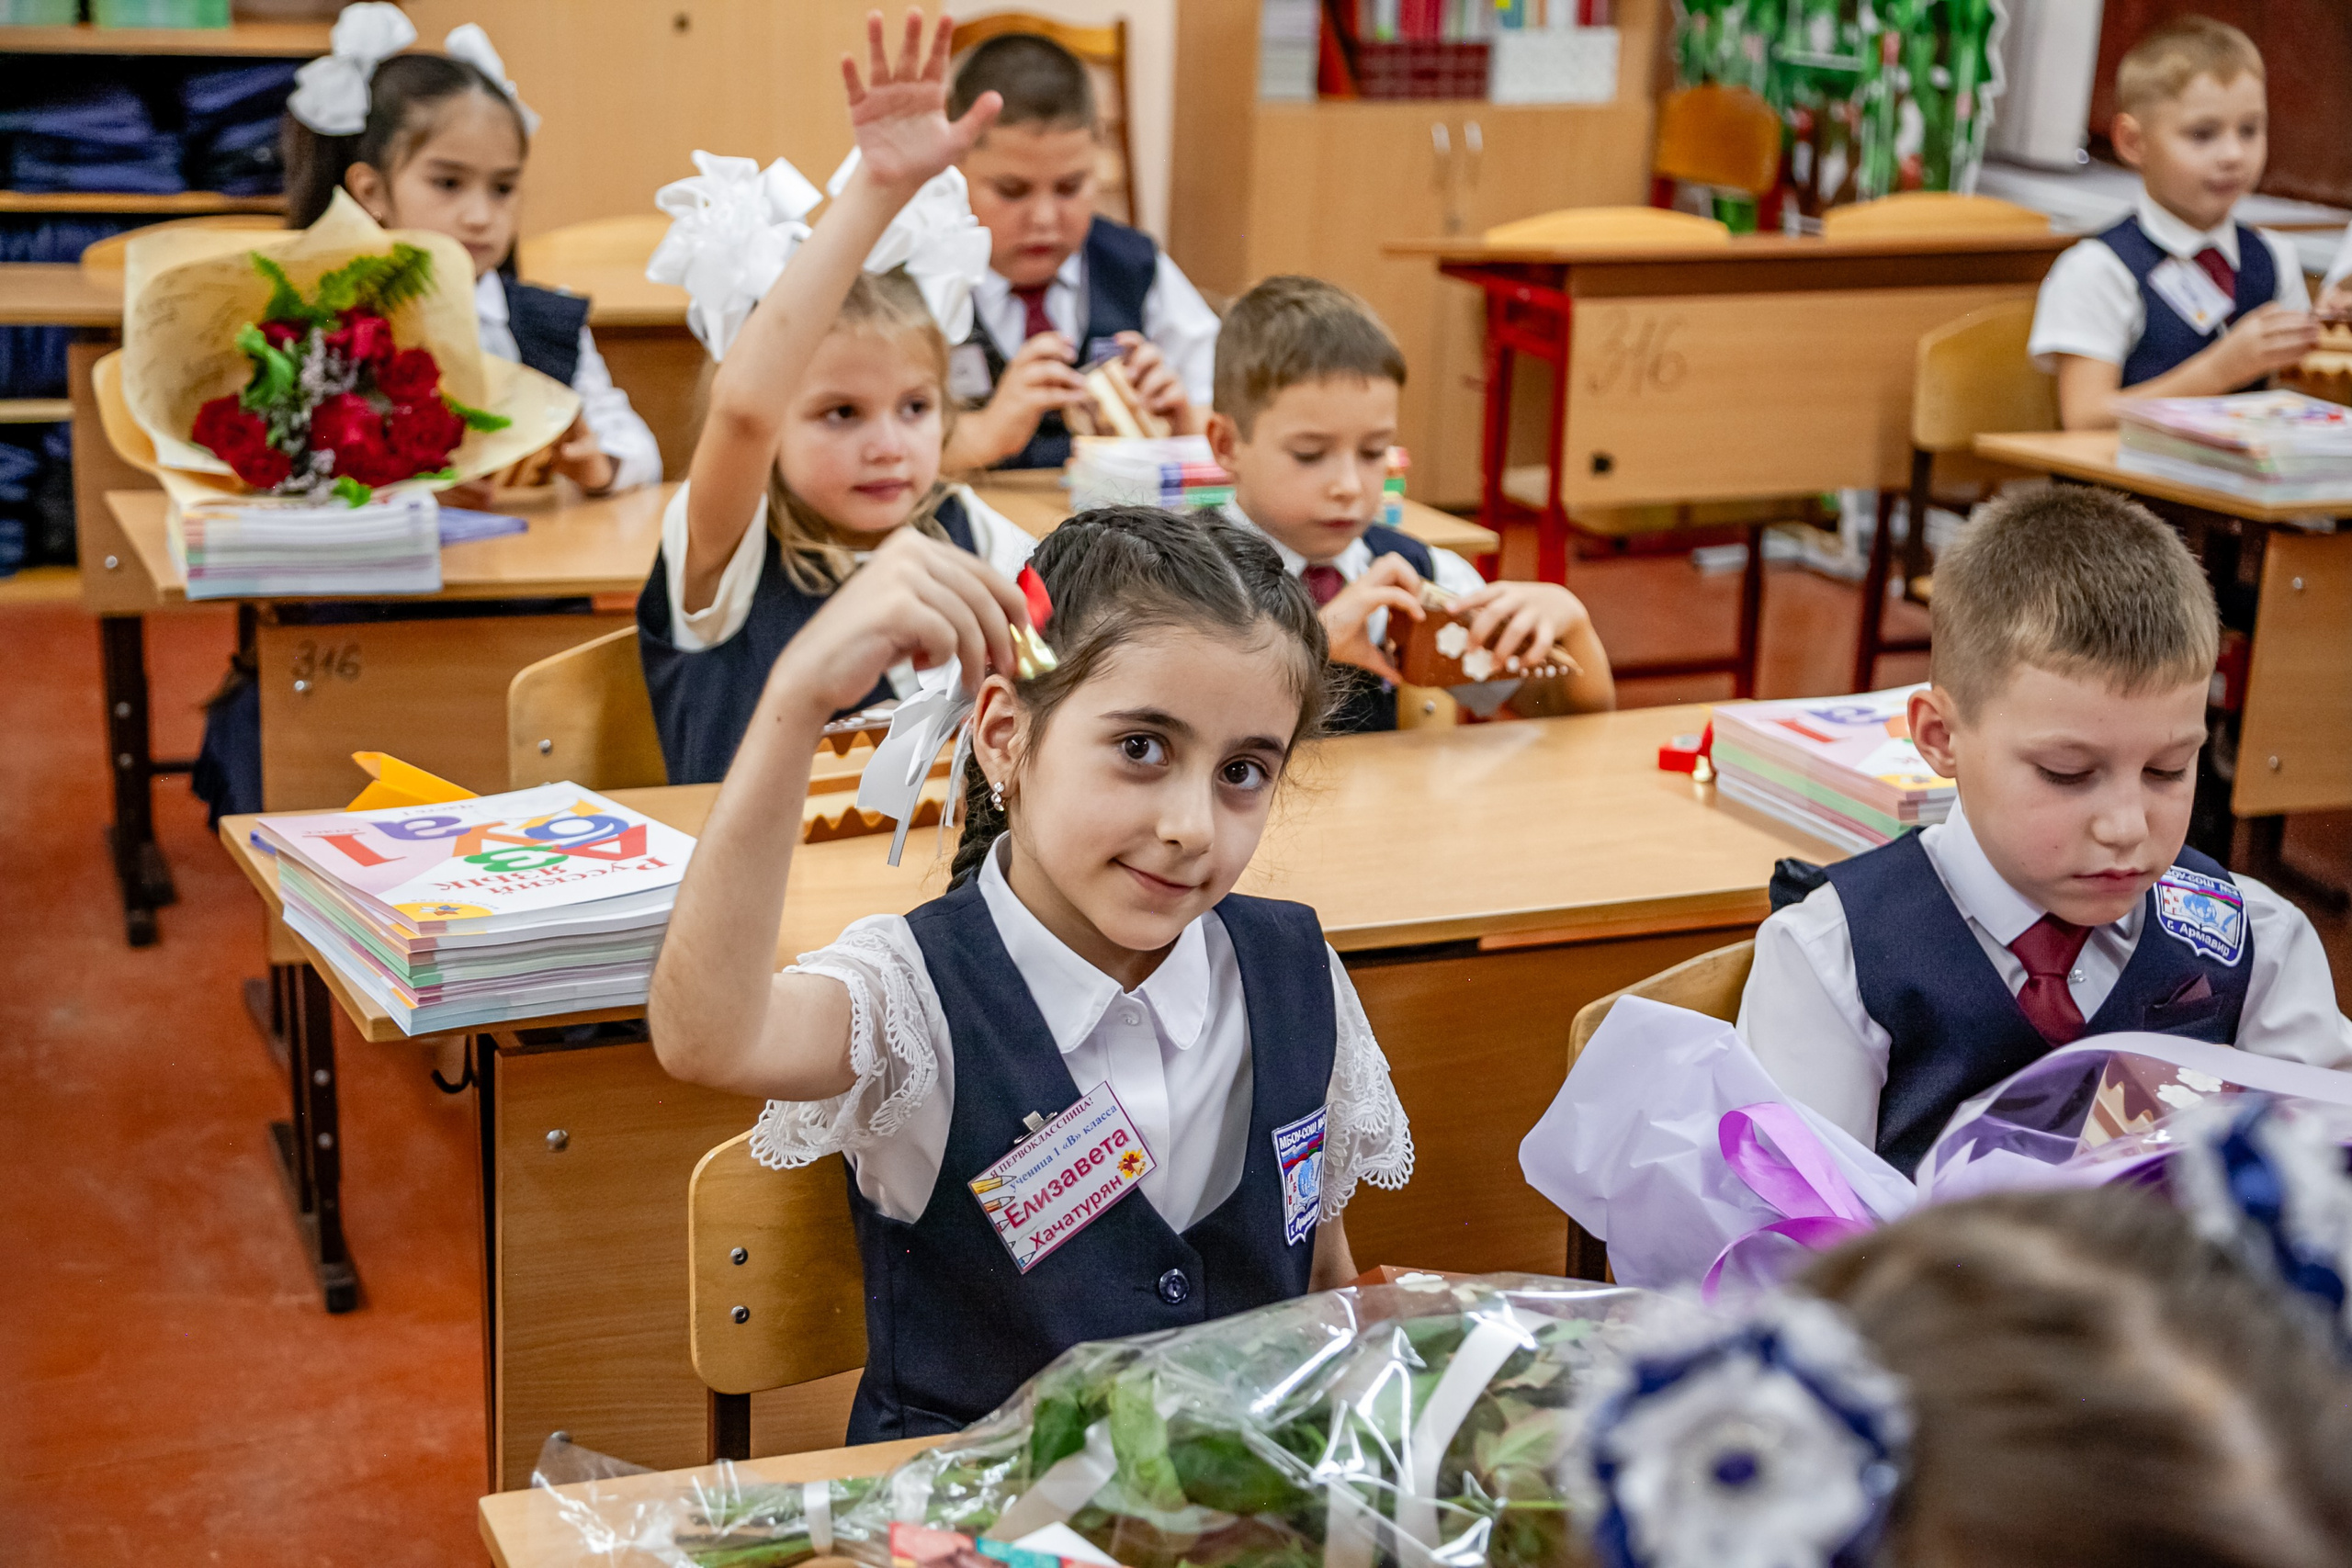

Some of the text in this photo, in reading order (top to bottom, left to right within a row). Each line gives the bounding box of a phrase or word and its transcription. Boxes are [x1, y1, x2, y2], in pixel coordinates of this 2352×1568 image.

[1586, 306, 1688, 396] 316
[292, 640, 362, 681] 316
[488, 856, 674, 895] Русский
[2179, 923, 2231, 957] Армавир
[999, 1097, 1094, 1174] ПЕРВОКЛАССНИЦА!
[1010, 1156, 1054, 1193] ученица
[1083, 1104, 1118, 1135] класса
[1004, 1127, 1131, 1229] Елизавета
[1029, 1175, 1124, 1251] Хачатурян
